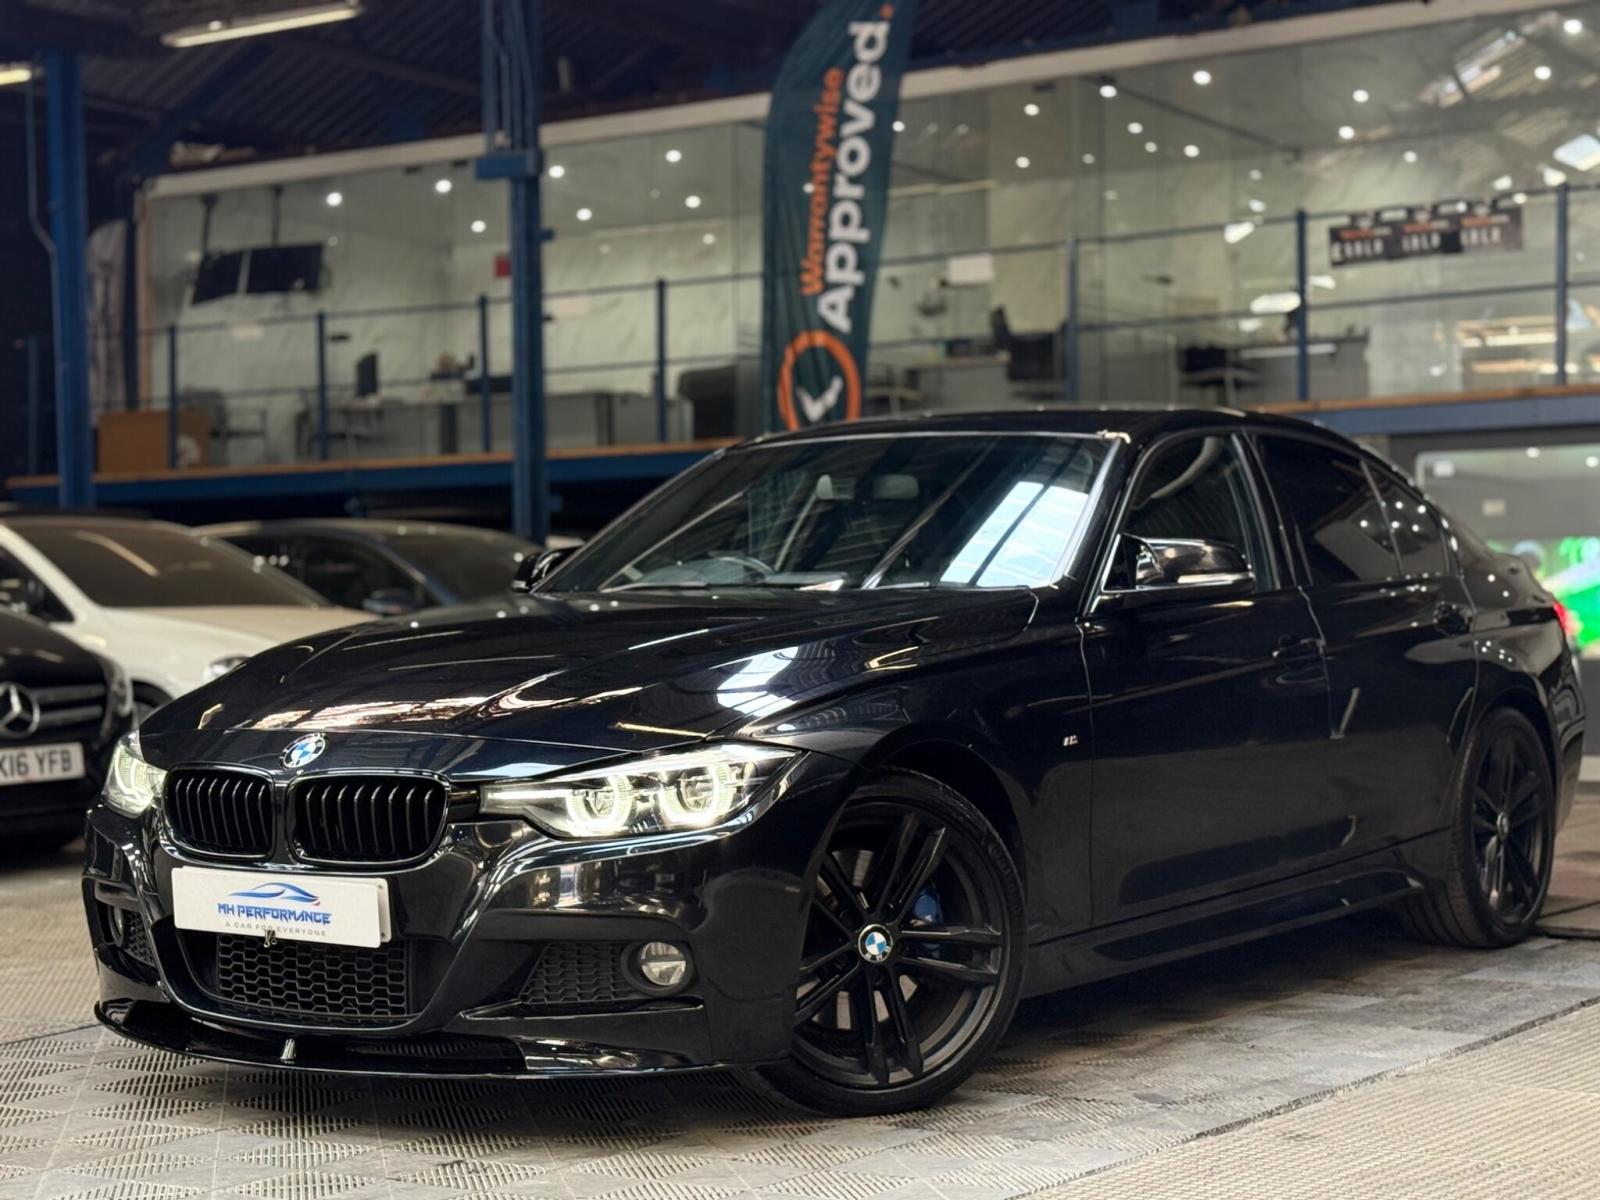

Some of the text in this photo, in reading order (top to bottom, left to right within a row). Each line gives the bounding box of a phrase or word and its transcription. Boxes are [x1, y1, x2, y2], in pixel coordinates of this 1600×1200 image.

[801, 66, 845, 296] Warrantywise
[36, 748, 73, 774] YFB
[237, 905, 331, 925] PERFORMANCE
[276, 926, 327, 937] EVERYONE
